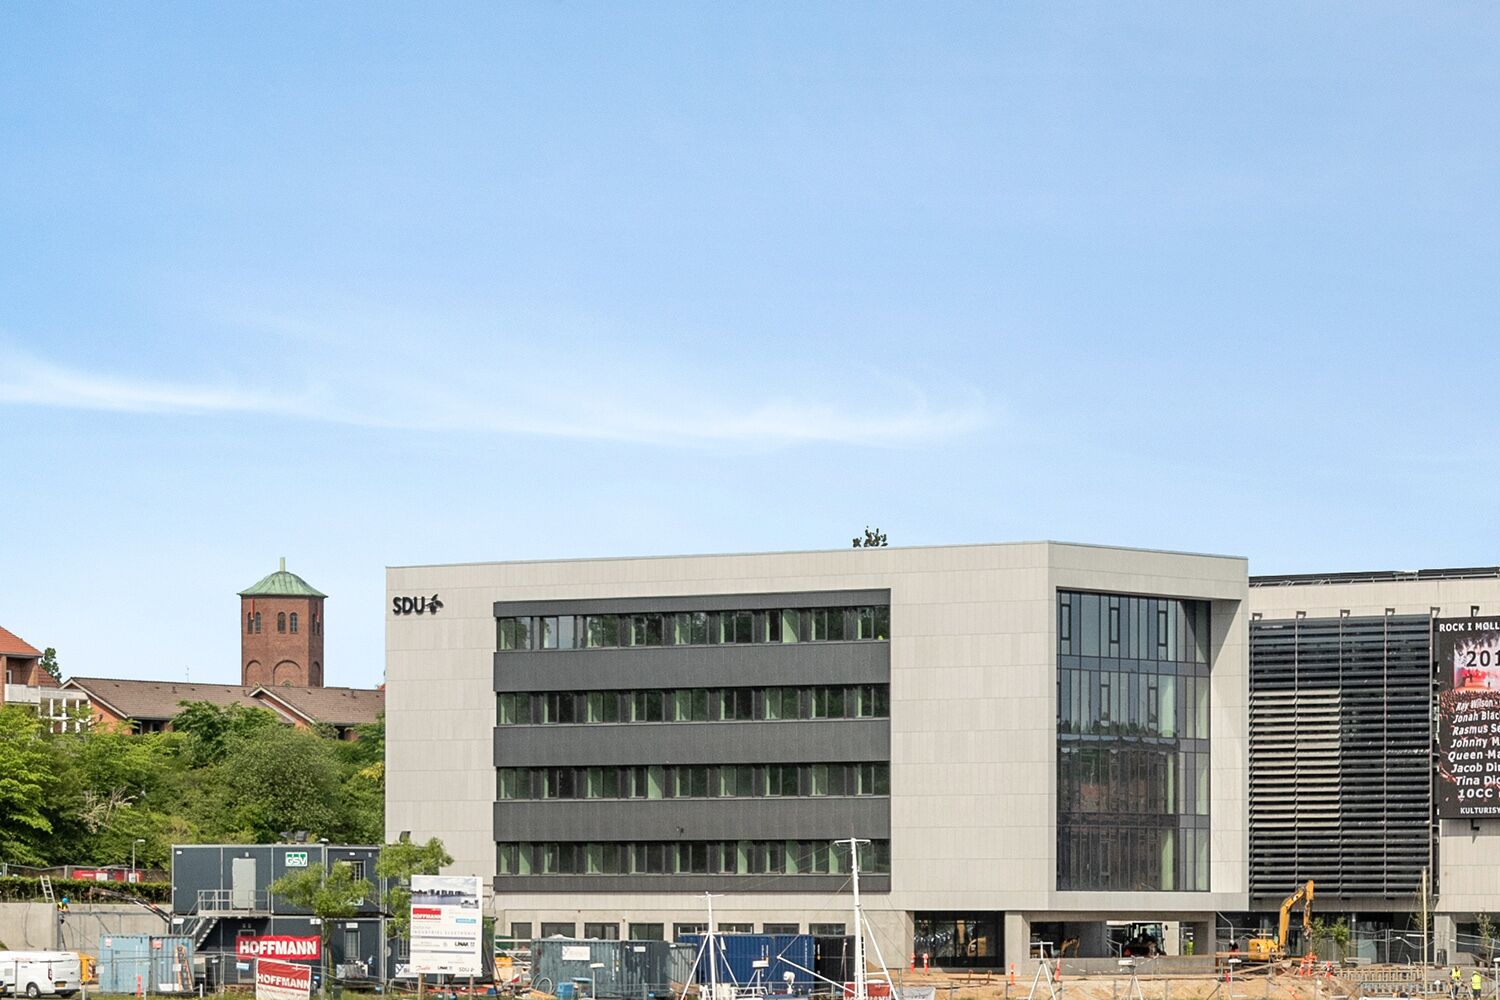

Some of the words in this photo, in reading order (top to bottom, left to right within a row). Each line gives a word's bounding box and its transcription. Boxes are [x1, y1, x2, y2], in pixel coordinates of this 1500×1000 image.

[392, 596, 426, 616] SDU
[1439, 622, 1465, 632] ROCK
[1467, 622, 1472, 631] I
[1452, 711, 1479, 724] Jonah
[1452, 725, 1488, 736] Rasmus
[1450, 737, 1488, 749] Johnny
[1448, 750, 1483, 762] Queen
[1450, 762, 1483, 773] Jacob
[1456, 775, 1480, 786] Tina
[1457, 788, 1493, 799] 10CC
[287, 857, 307, 866] GSV
[239, 940, 317, 955] HOFFMANN
[256, 973, 310, 989] HOFFMANN
